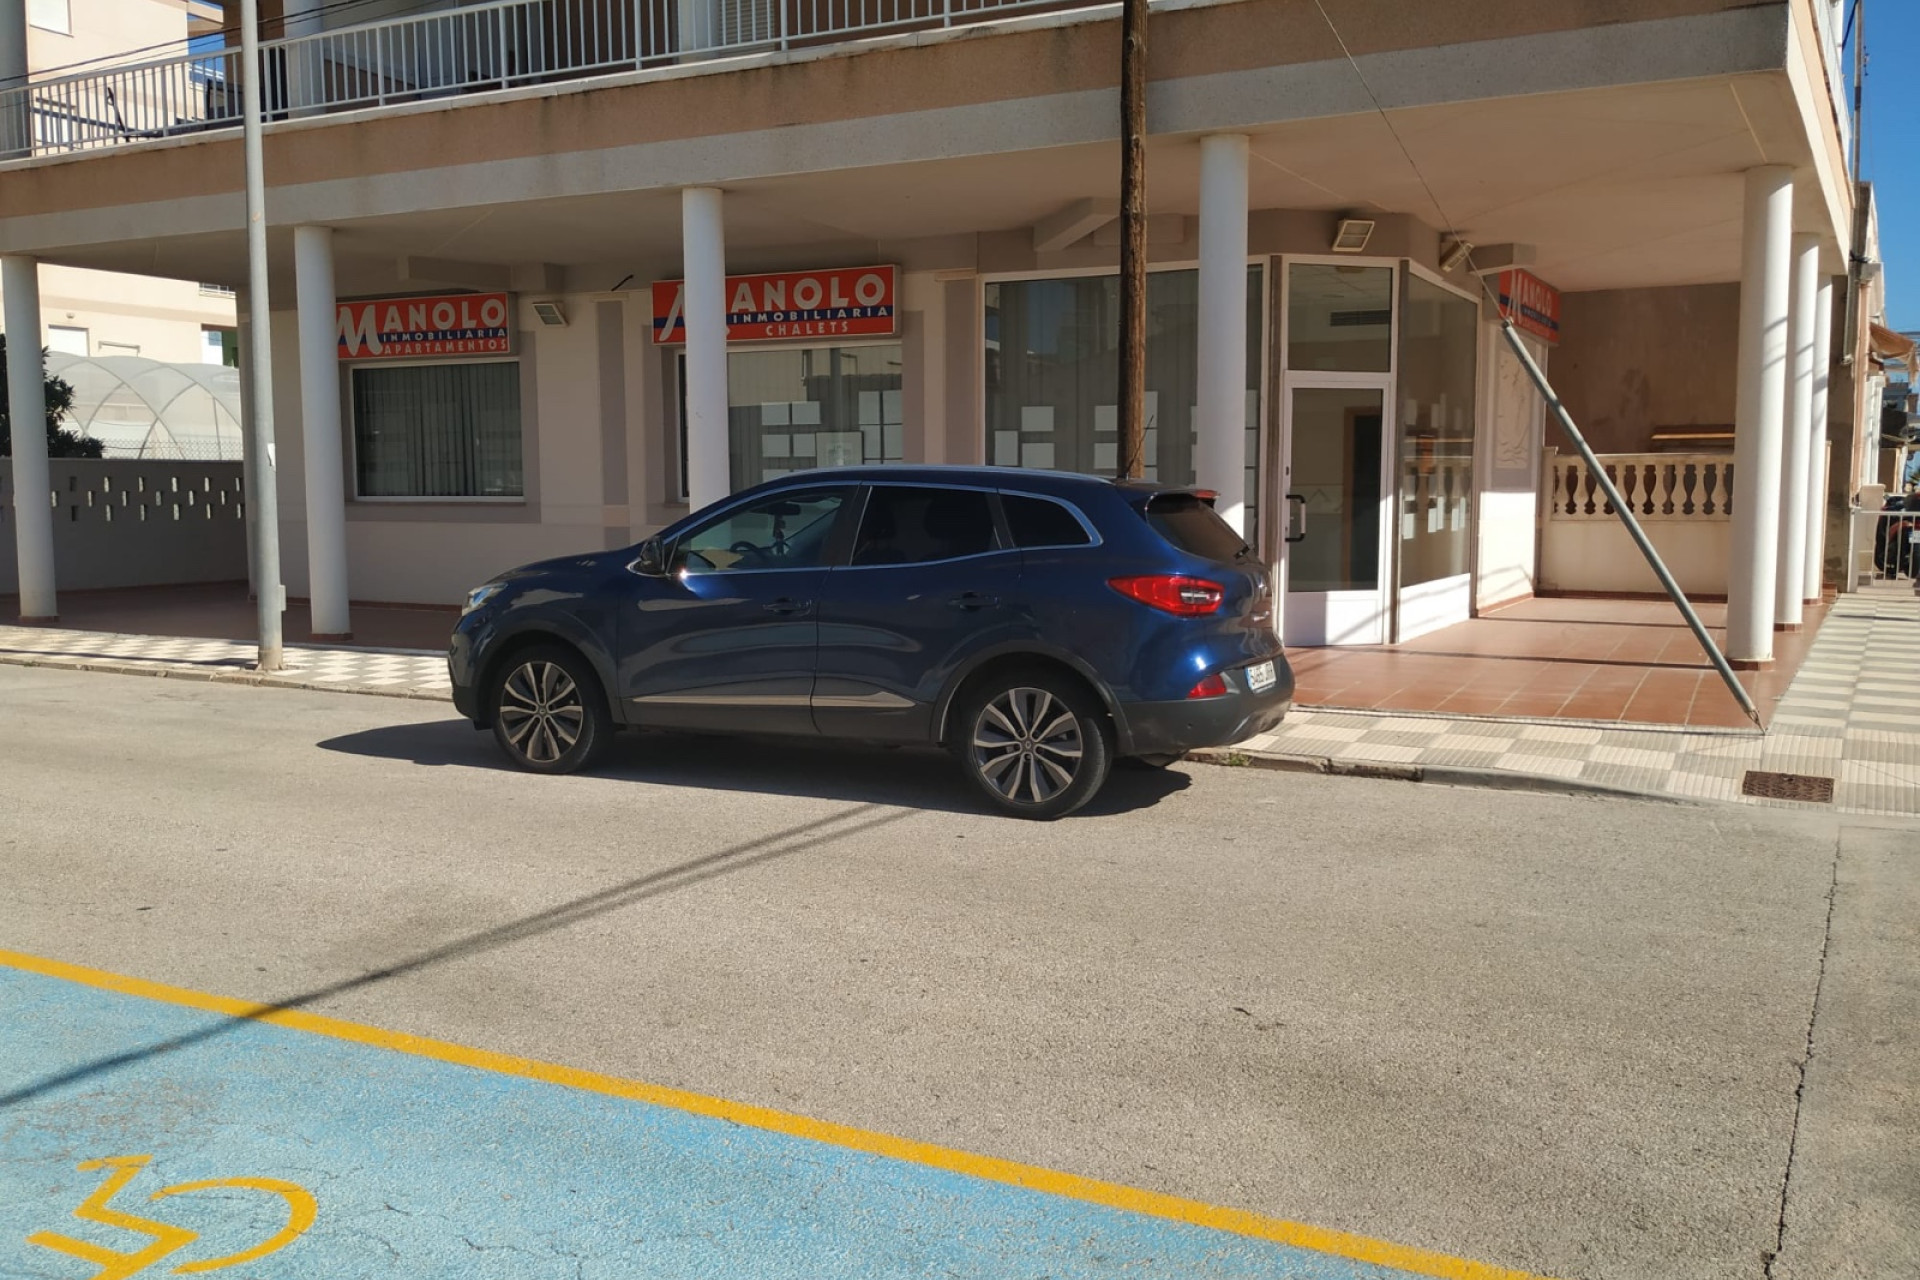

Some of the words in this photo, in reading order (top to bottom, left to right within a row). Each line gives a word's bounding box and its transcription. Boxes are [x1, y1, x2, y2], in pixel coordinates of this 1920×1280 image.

[733, 306, 888, 324] INMOBILIARIA
[336, 299, 505, 356] MANOLO
[383, 328, 506, 343] INMOBILIARIA
[766, 321, 849, 337] CHALETS
[384, 339, 506, 355] APARTAMENTOS
